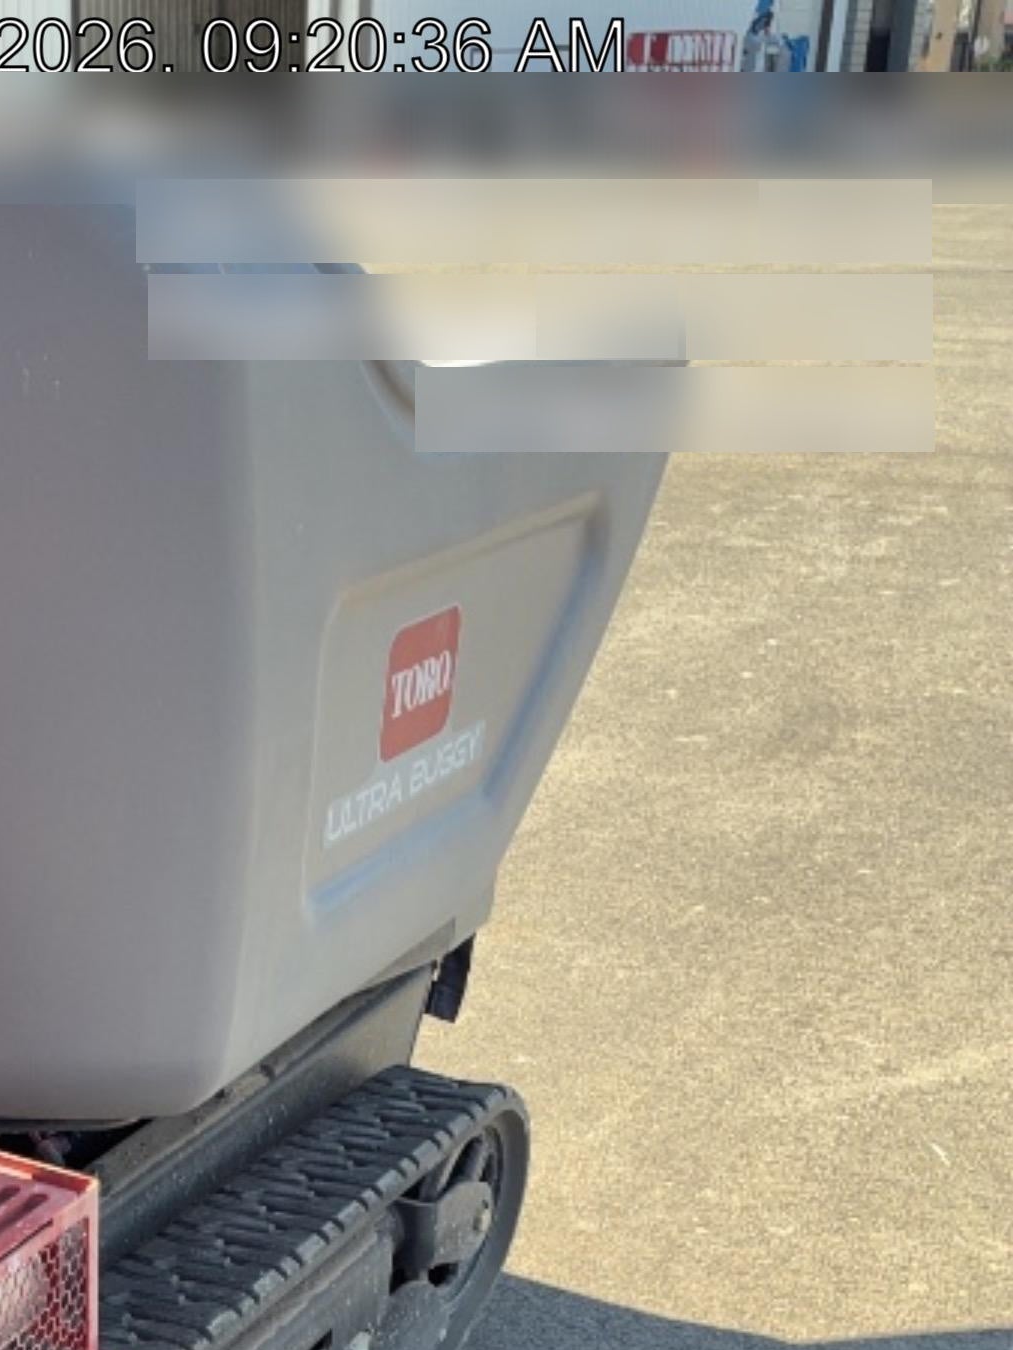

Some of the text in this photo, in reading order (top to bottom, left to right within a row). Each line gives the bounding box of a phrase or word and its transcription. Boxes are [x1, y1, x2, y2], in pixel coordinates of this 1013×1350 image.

[390, 649, 453, 720] TORO
[323, 724, 485, 842] ULTRA BUGGY
